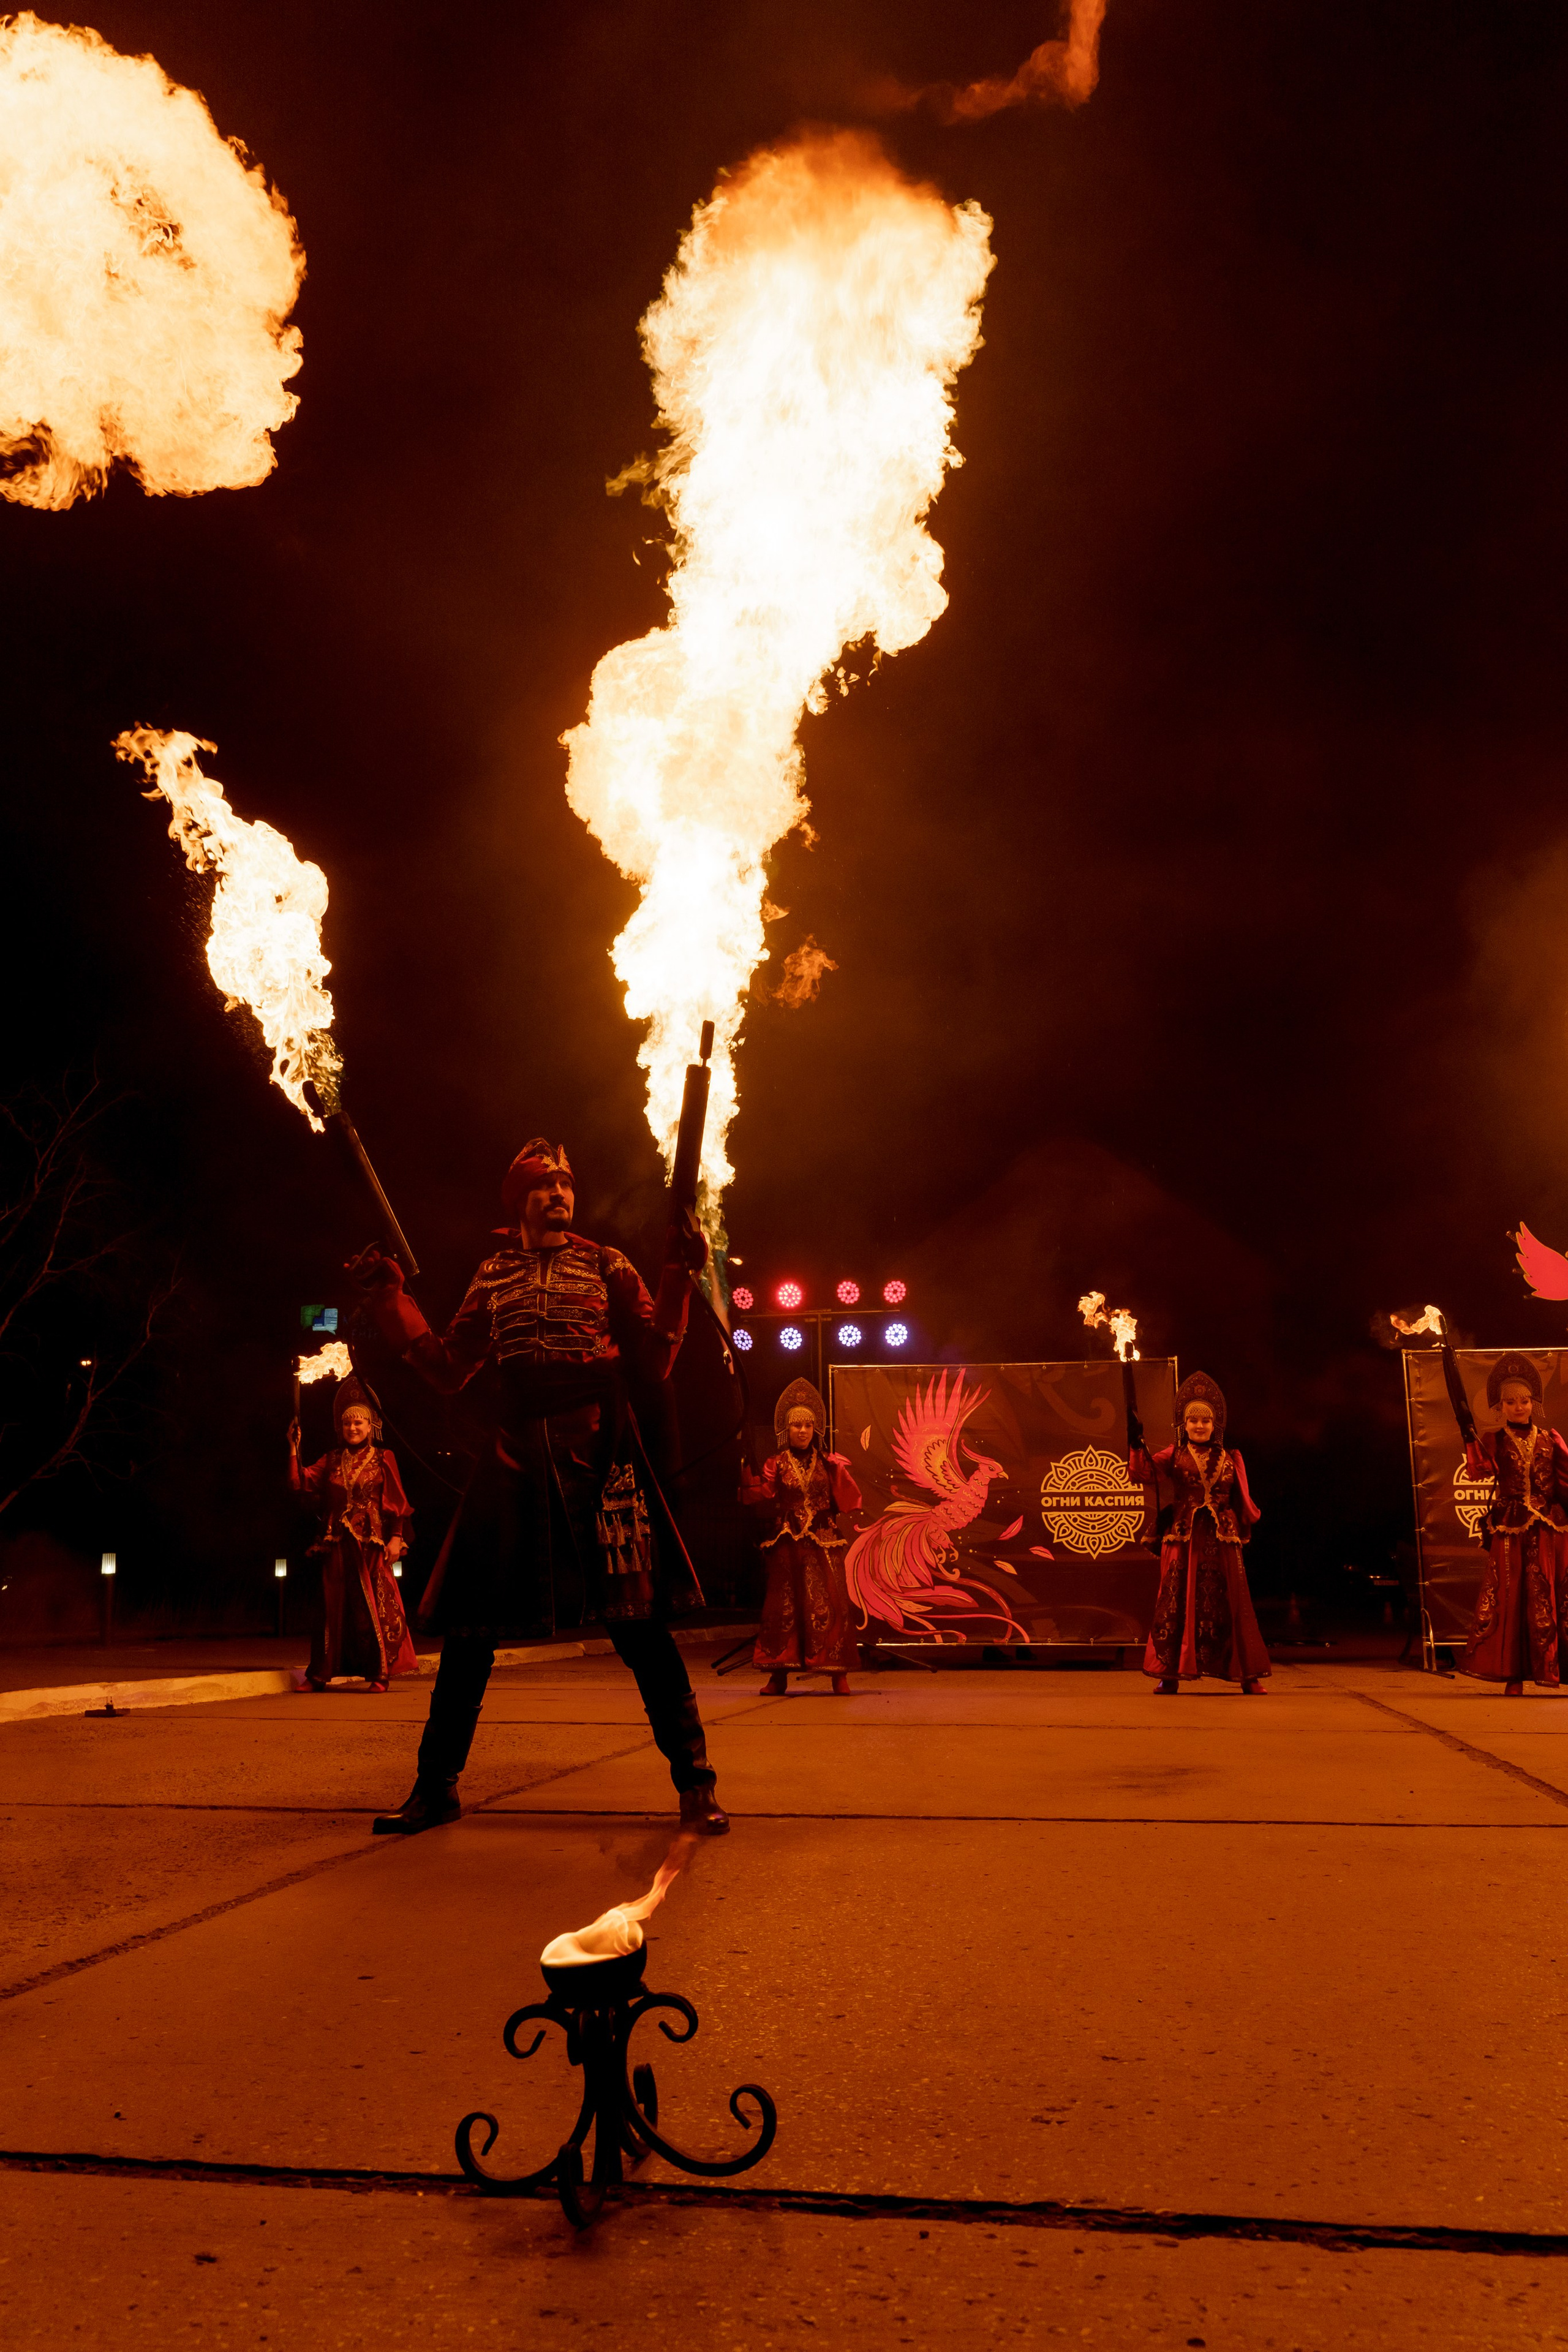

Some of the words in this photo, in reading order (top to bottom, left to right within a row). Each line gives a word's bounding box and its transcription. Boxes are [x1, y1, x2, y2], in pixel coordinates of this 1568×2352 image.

[1454, 1490, 1496, 1500] ОГНИ
[1041, 1496, 1080, 1507] ОГНИ
[1085, 1496, 1144, 1506] КАСПИЯ
